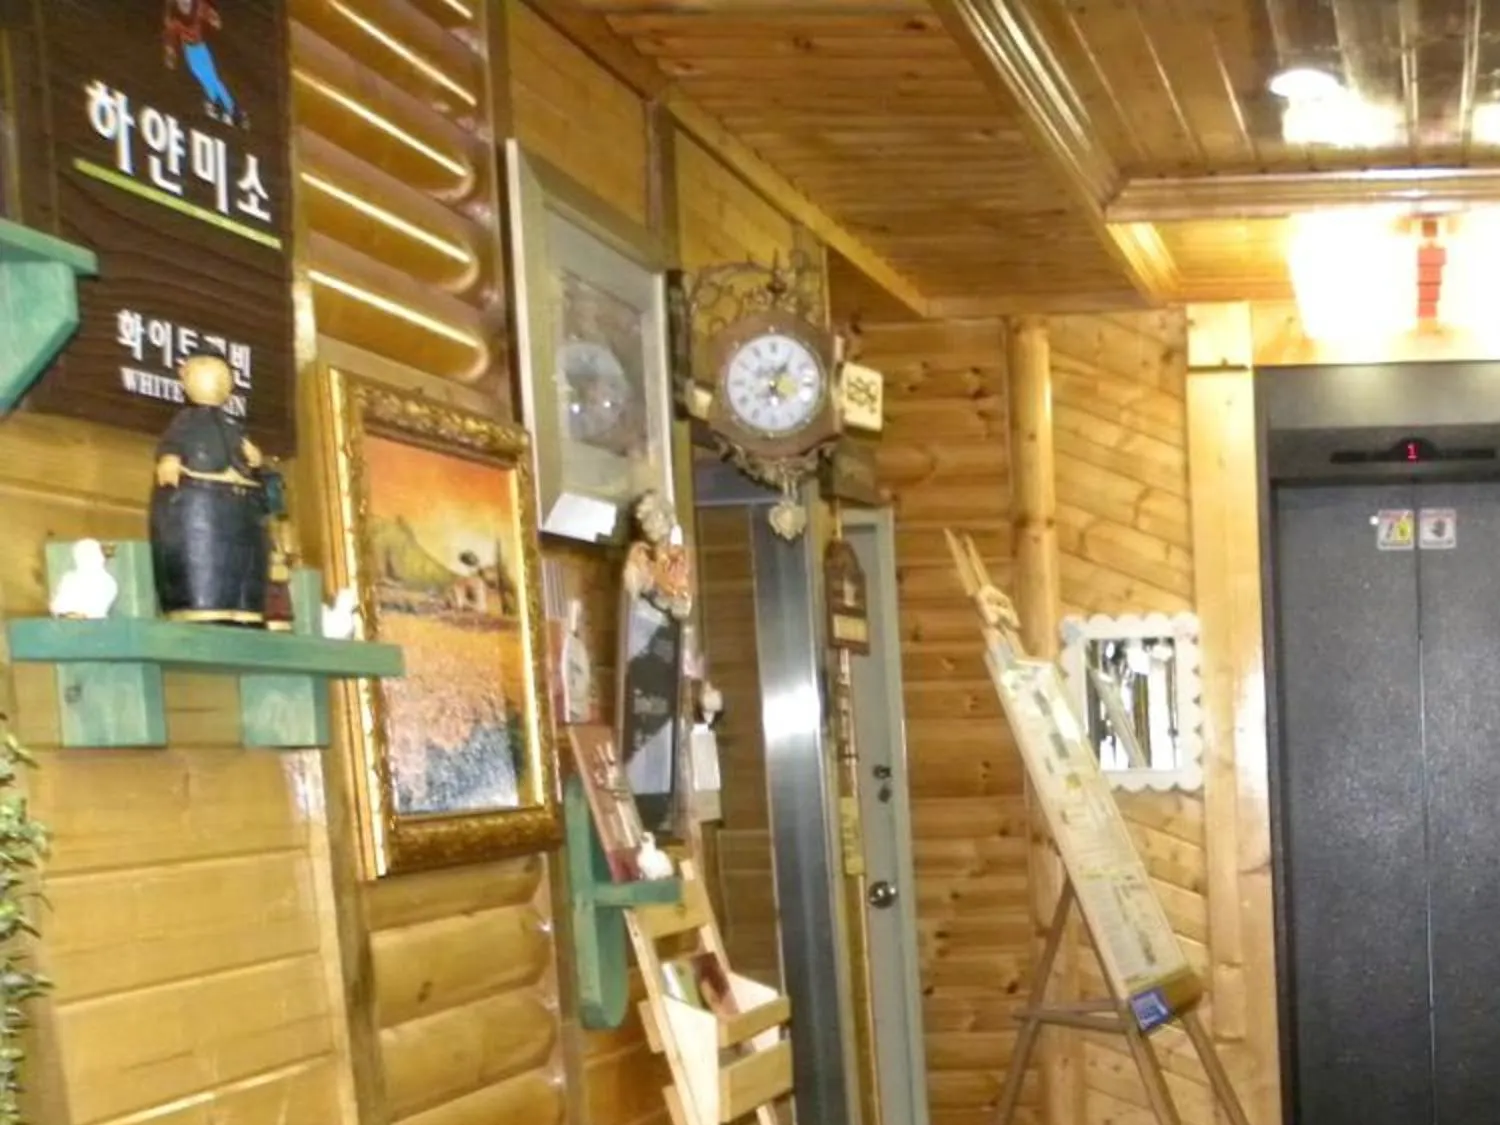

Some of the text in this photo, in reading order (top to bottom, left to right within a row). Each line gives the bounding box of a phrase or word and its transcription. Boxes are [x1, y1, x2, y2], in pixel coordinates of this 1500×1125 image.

[85, 80, 270, 221] 하얀미소
[120, 367, 185, 404] WHITE
[1406, 443, 1418, 460] 1
